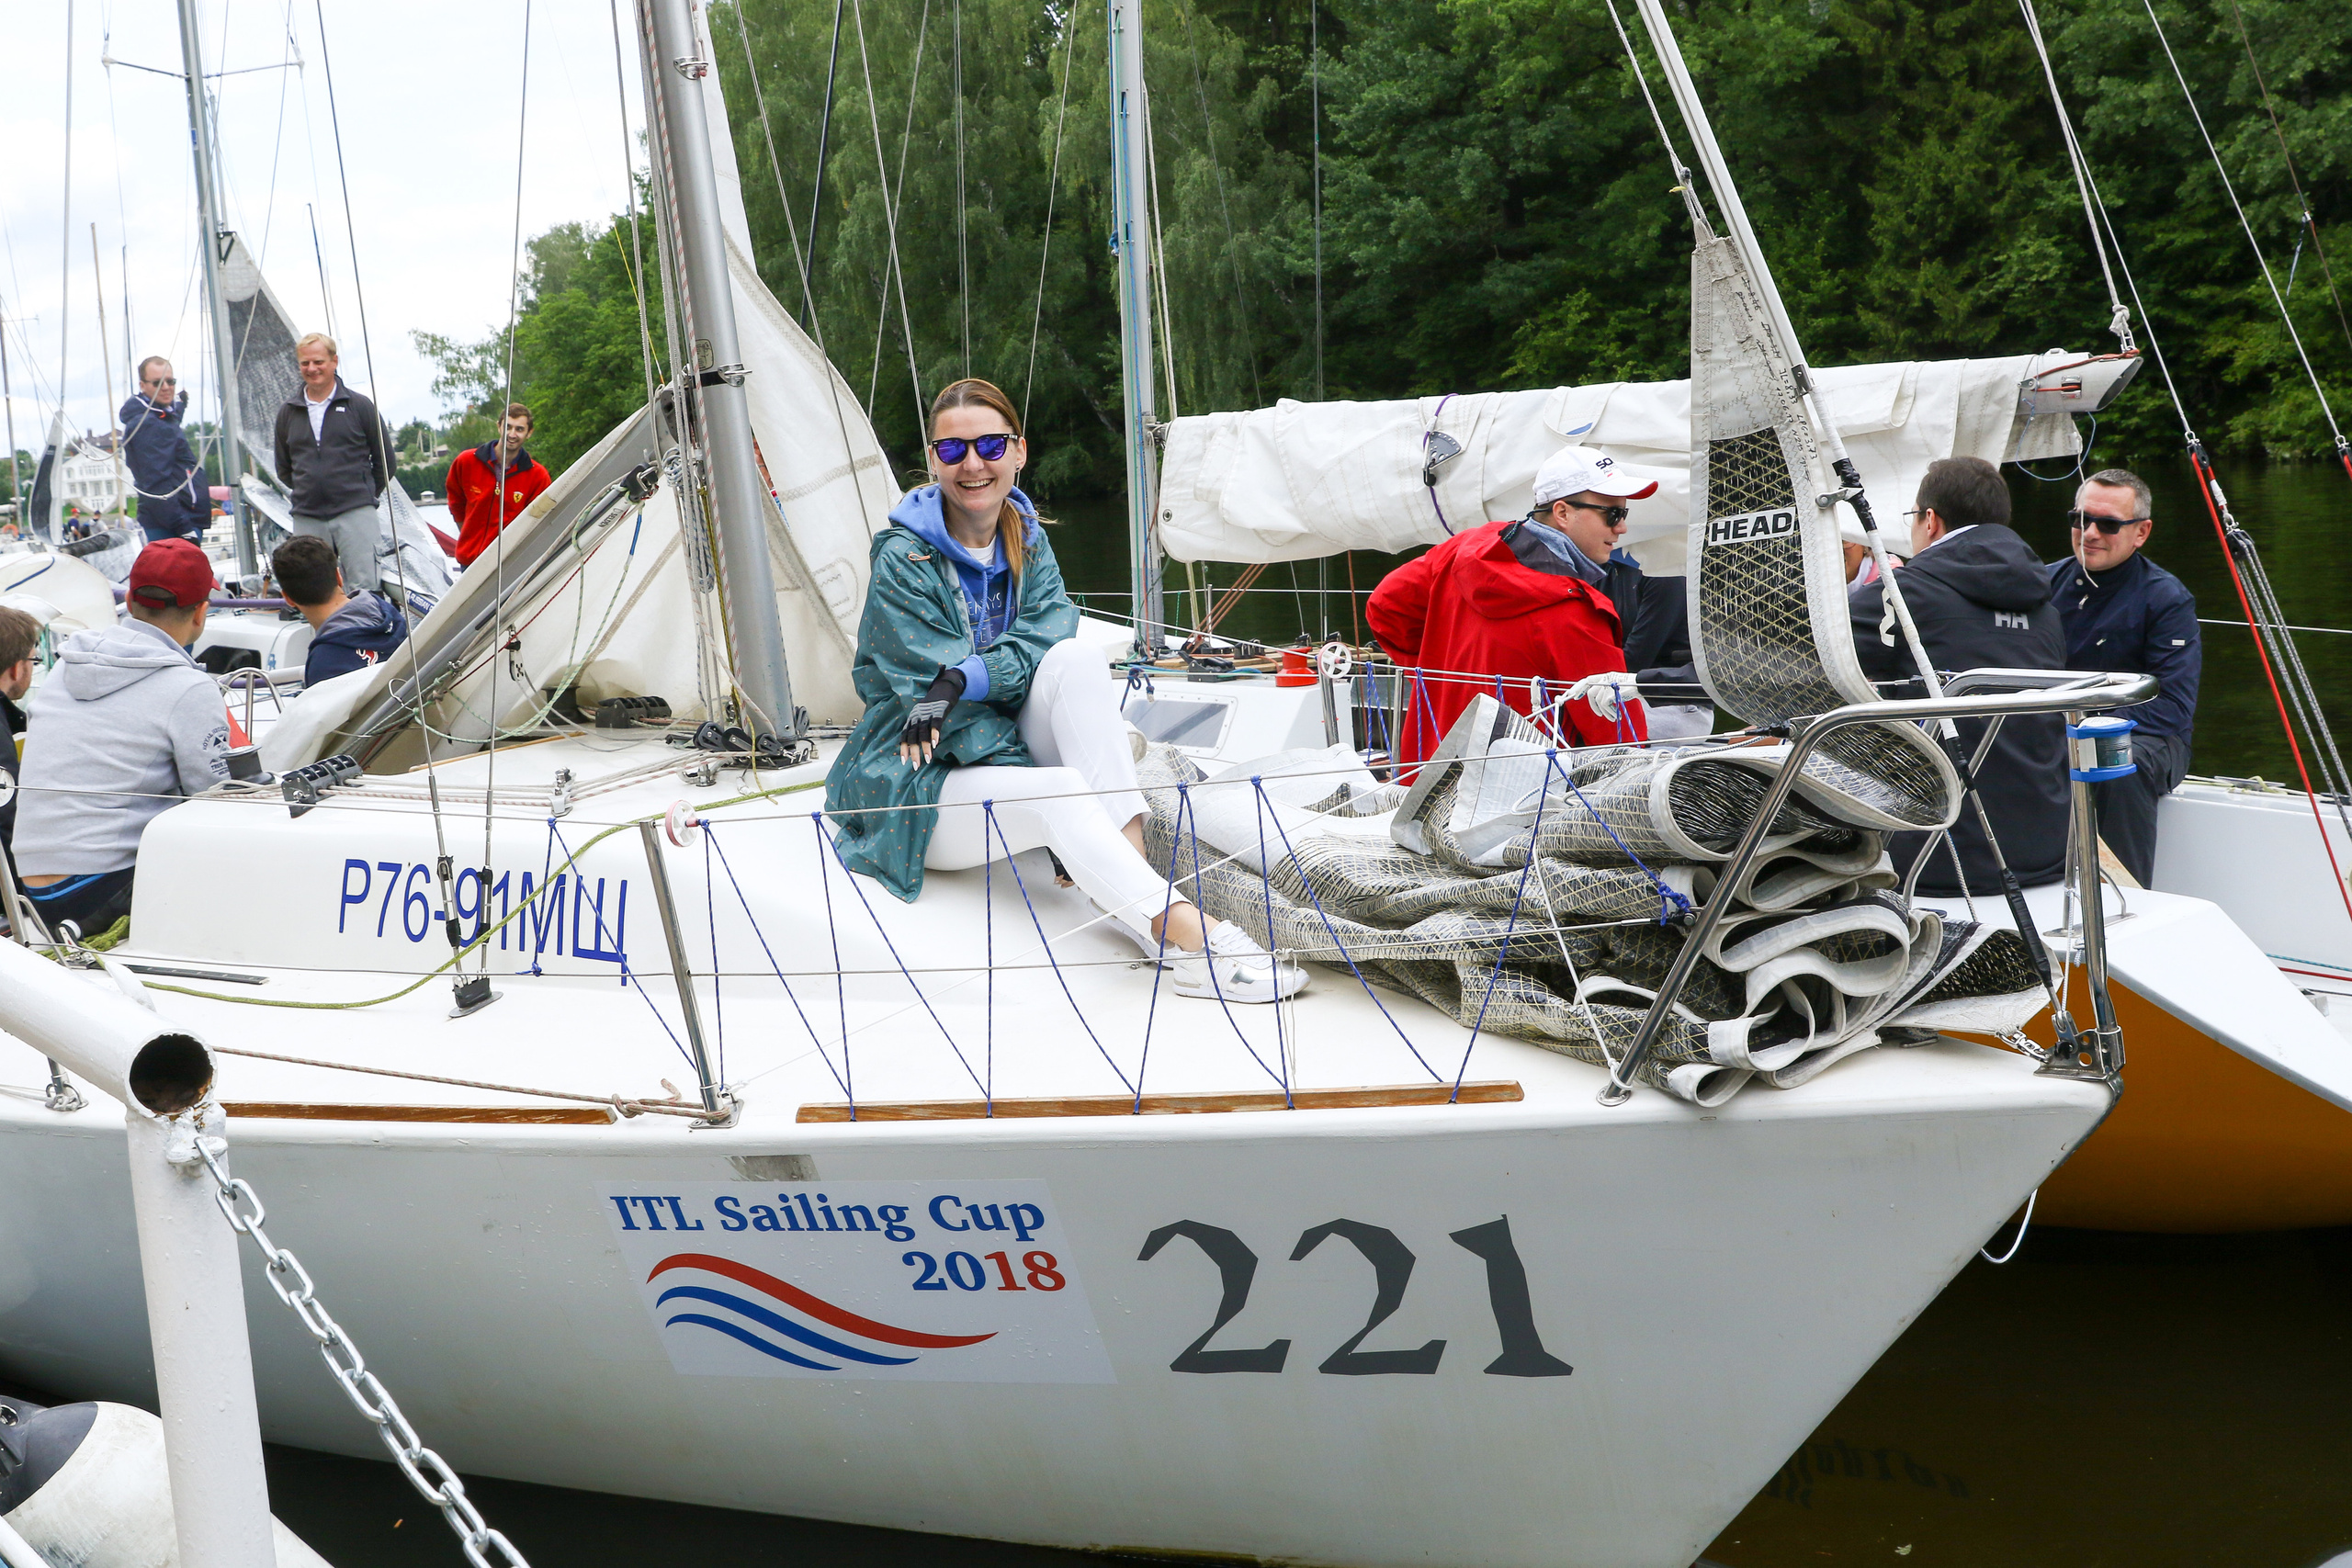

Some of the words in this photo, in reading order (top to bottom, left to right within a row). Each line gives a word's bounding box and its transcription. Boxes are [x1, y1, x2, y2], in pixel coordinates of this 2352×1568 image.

[1711, 512, 1792, 542] HEAD
[1994, 611, 2030, 630] HH
[609, 1195, 704, 1232] ITL
[719, 1192, 917, 1243] Sailing
[928, 1195, 1045, 1242] Cup
[901, 1250, 1067, 1292] 2018
[1136, 1213, 1574, 1378] 221
